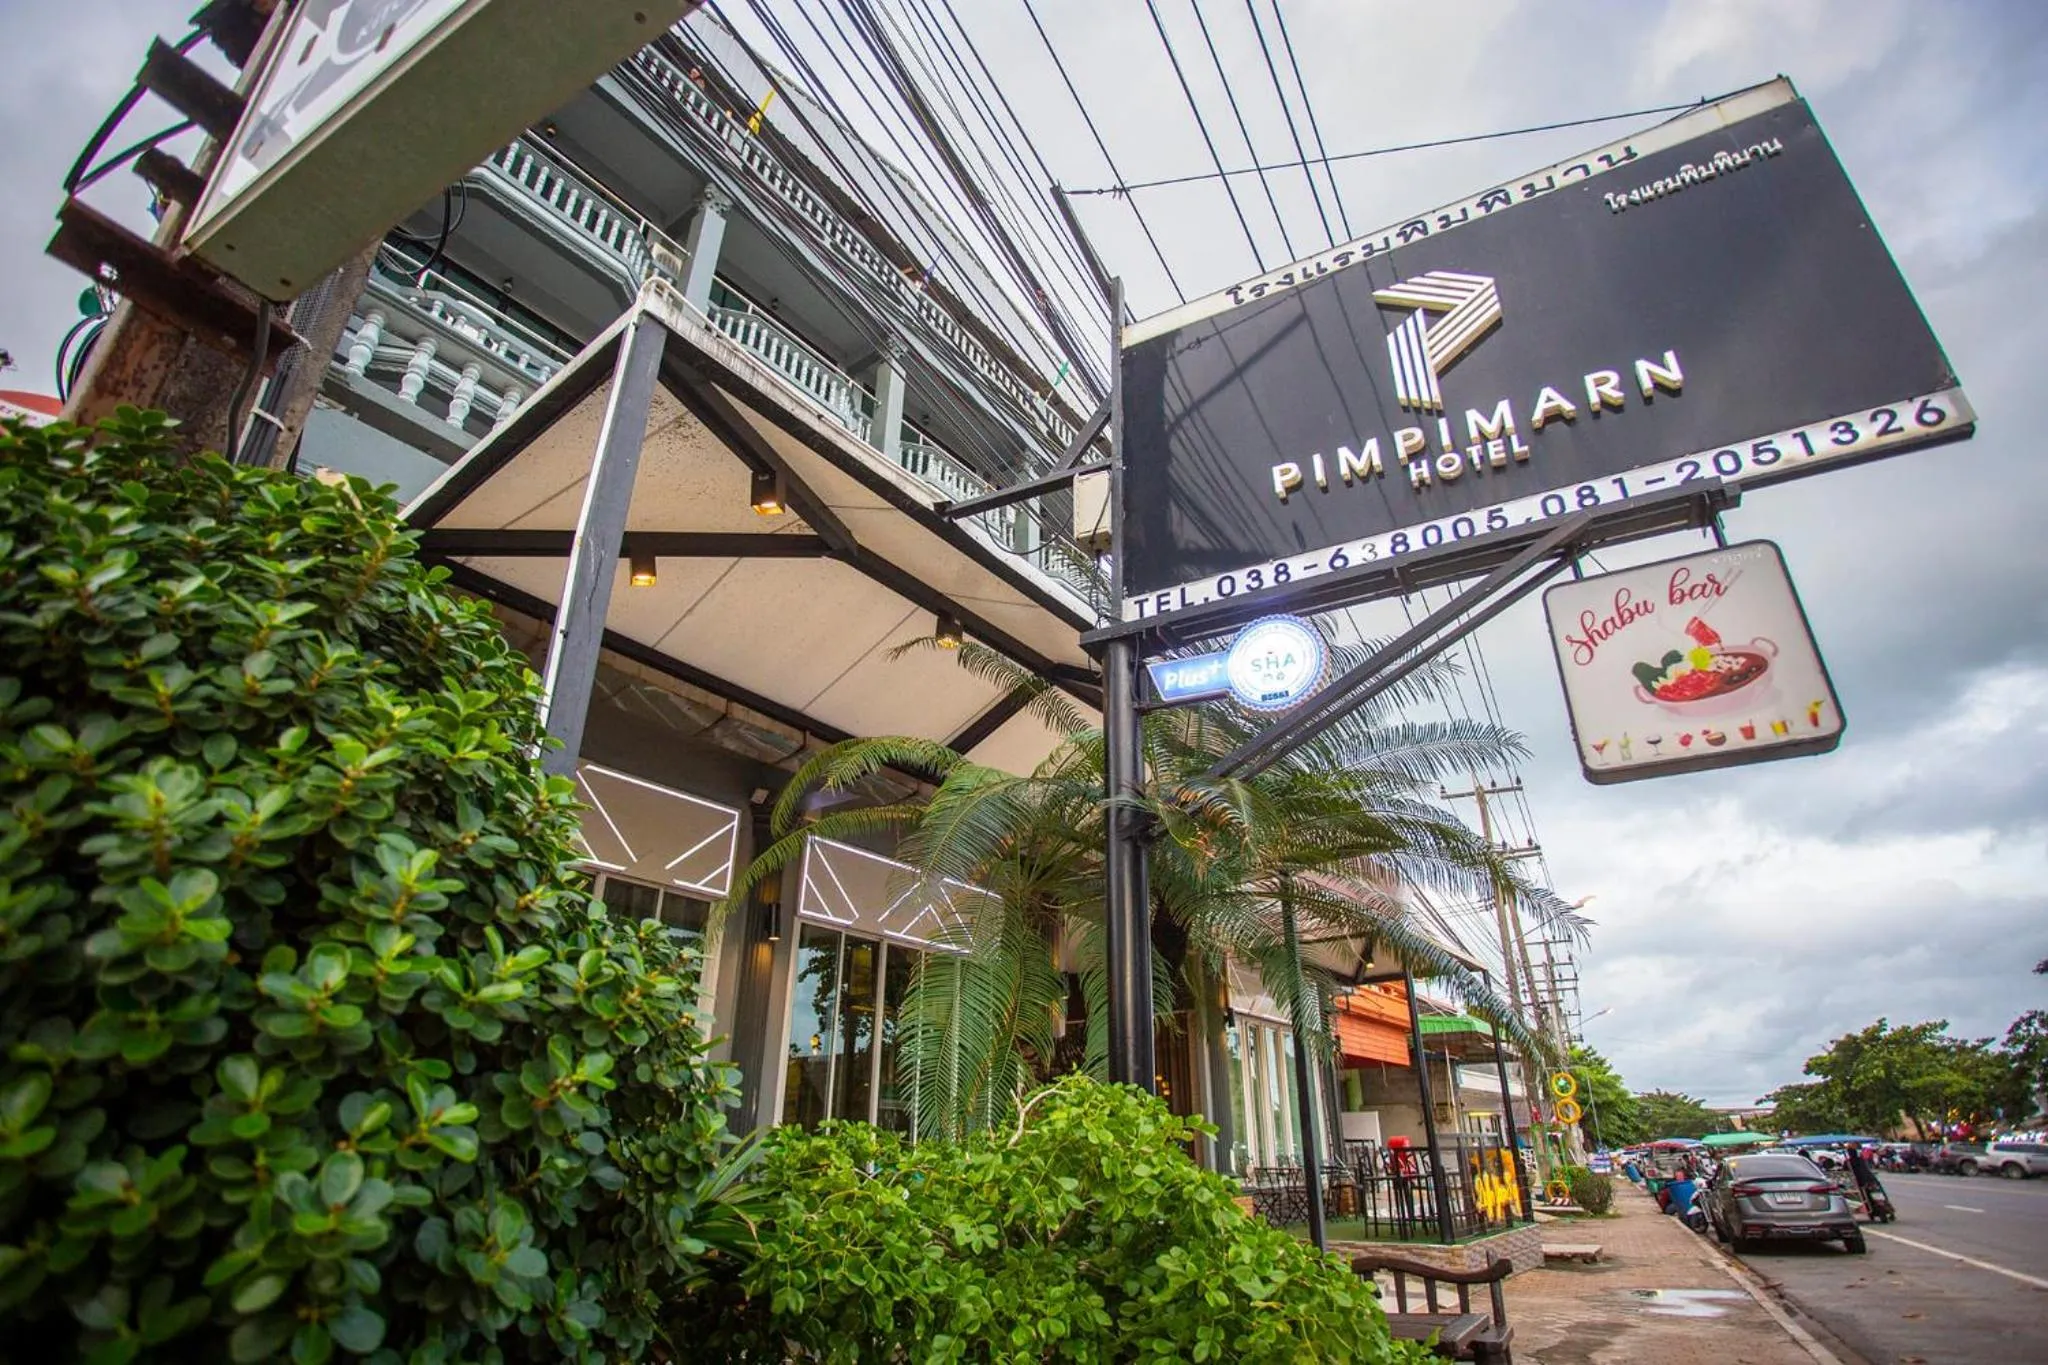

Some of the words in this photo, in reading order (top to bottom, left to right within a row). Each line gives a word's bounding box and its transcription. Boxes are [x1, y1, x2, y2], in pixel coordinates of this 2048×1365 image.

[1603, 136, 1784, 213] โรงแรมพิมพิมาน
[1225, 144, 1638, 305] โรงแรมพิมพิมาน
[1271, 349, 1685, 501] PIMPIMARN
[1408, 433, 1531, 489] HOTEL
[1668, 567, 1730, 607] bar
[1250, 651, 1297, 673] SHA
